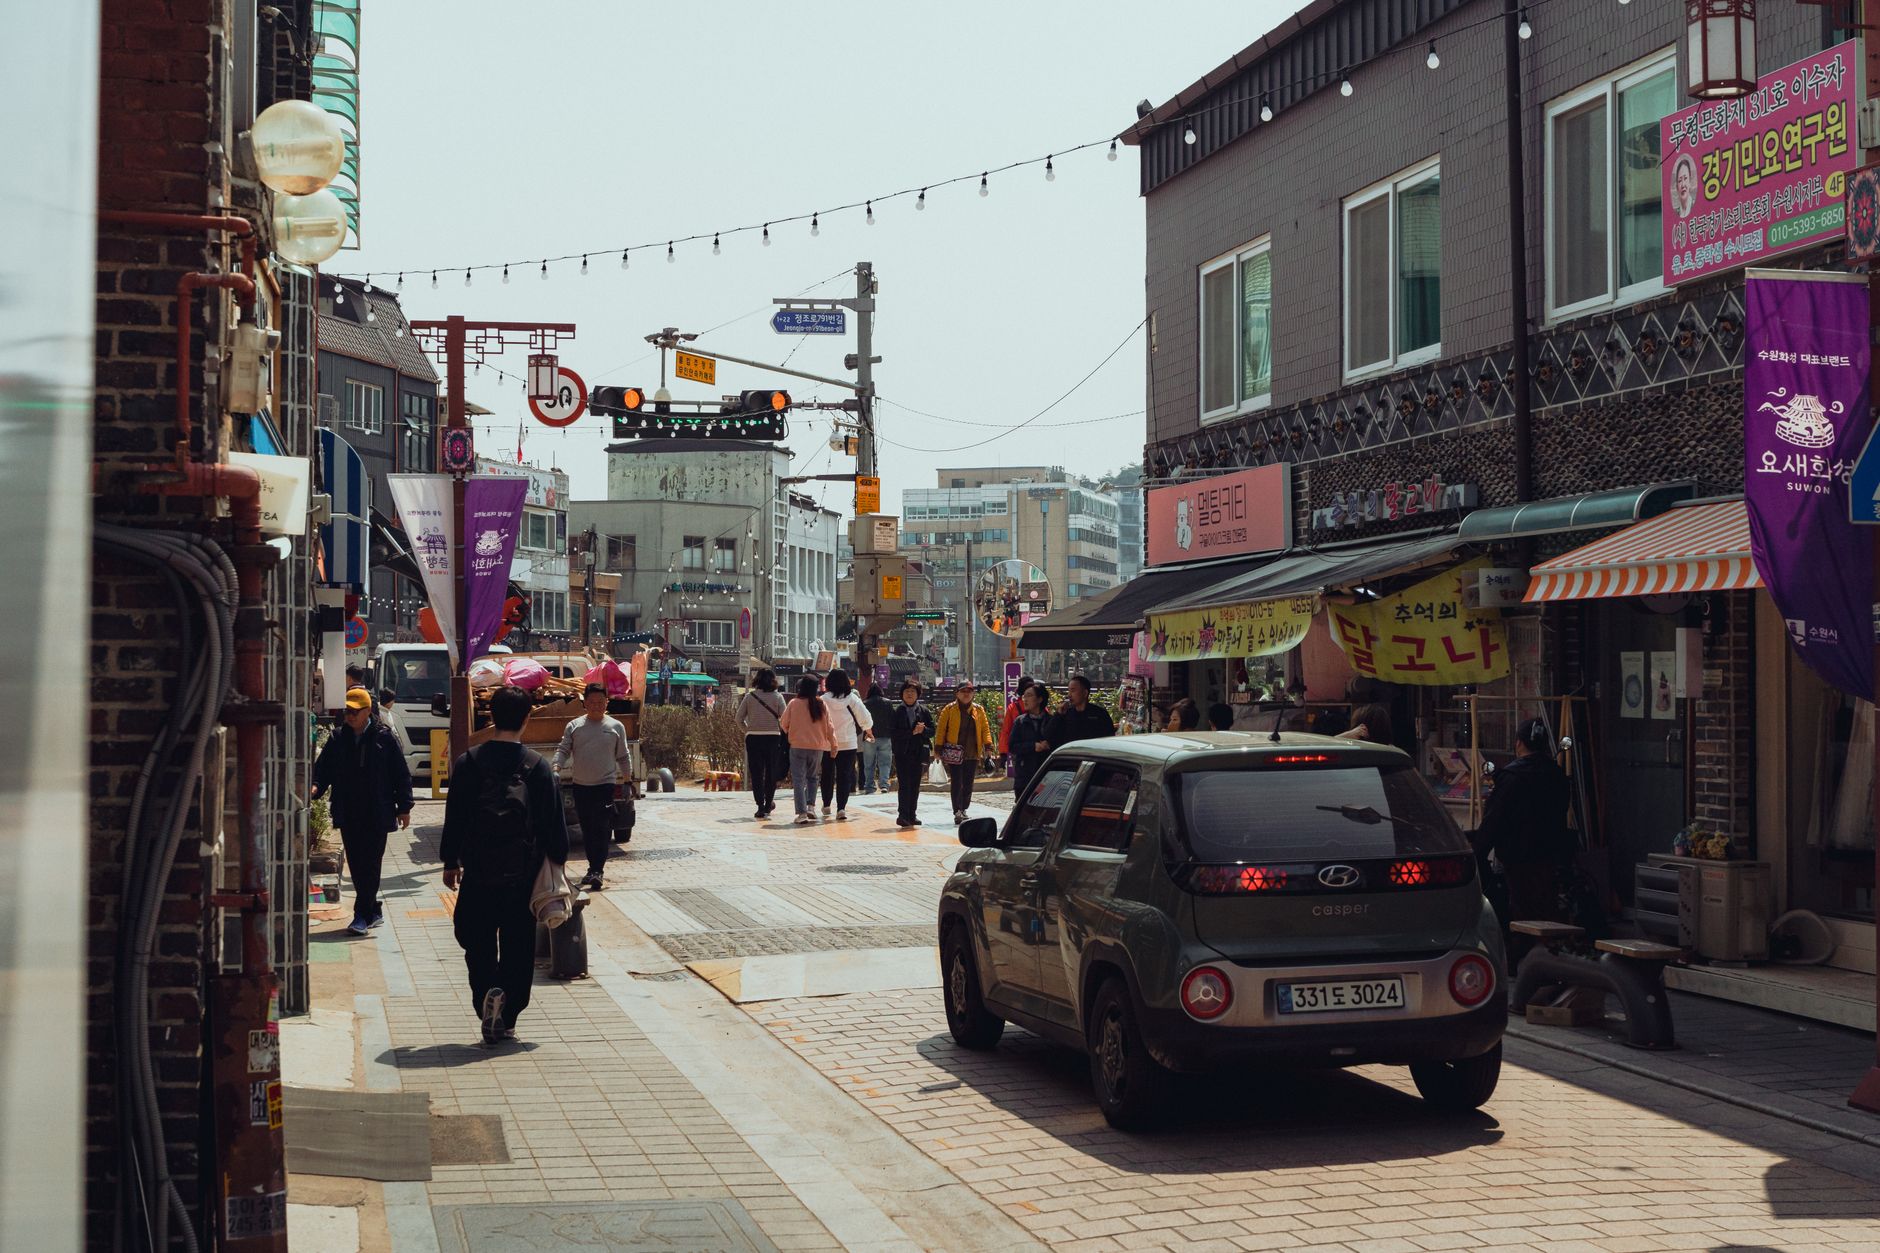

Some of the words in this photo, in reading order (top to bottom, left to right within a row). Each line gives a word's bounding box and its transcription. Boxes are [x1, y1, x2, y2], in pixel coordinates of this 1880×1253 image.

[1669, 96, 1746, 153] 무형문화재
[1750, 81, 1788, 120] 31호
[1791, 53, 1846, 103] 이수자
[1702, 100, 1848, 200] 경기민요연구원
[1688, 192, 1772, 243] 한국경기소리보존회
[1772, 174, 1824, 218] 수원시지부
[1829, 173, 1844, 194] 4F
[1723, 228, 1764, 260] 수시모집
[1770, 207, 1845, 243] 010-5393-6850
[794, 313, 844, 325] 정조로791번길
[1757, 349, 1797, 364] 수원화성
[1800, 353, 1851, 367] 대표브랜드
[1756, 450, 1855, 485] 요새화성
[1383, 474, 1441, 521] 달고나
[1786, 481, 1831, 495] SUWON
[1197, 482, 1247, 527] 멜팅키티
[1394, 602, 1457, 623] 추억의
[1246, 624, 1254, 652] 볼
[1257, 629, 1266, 649] 수
[1335, 612, 1500, 675] 달고나
[1809, 626, 1839, 640] 수원시
[1312, 903, 1369, 917] casper
[1294, 987, 1346, 1008] 331도
[1350, 983, 1399, 1005] 3024
